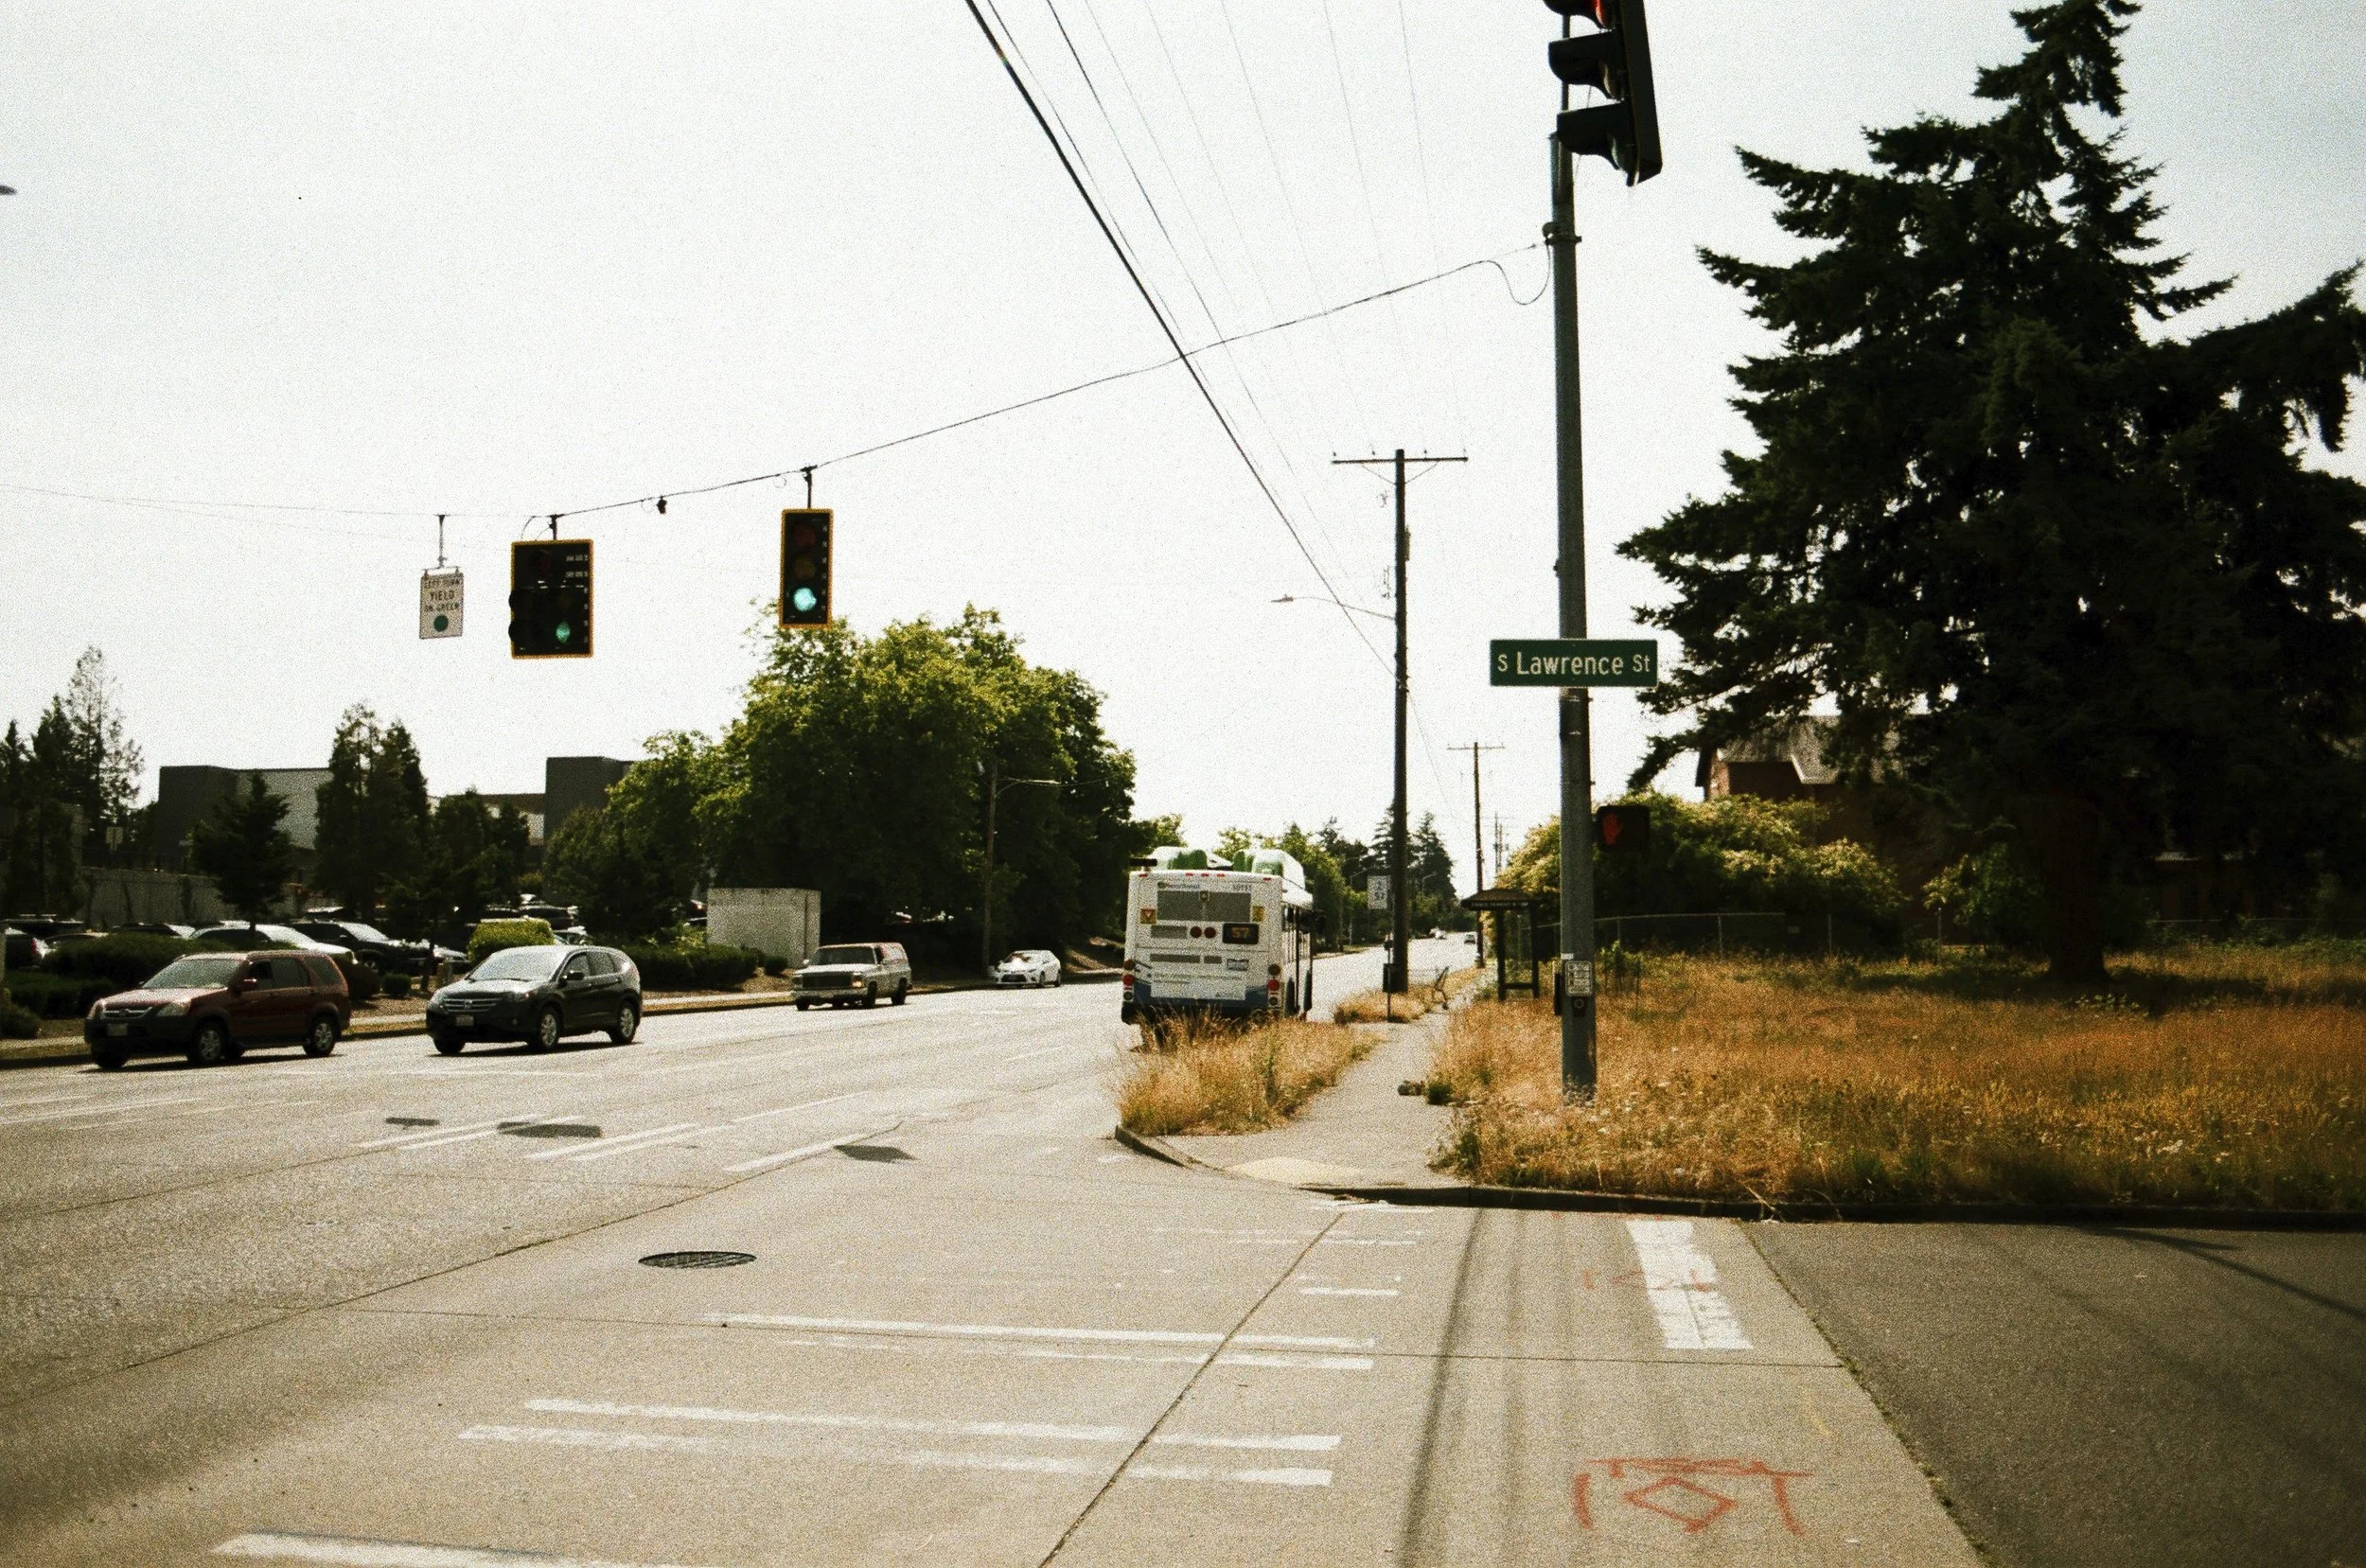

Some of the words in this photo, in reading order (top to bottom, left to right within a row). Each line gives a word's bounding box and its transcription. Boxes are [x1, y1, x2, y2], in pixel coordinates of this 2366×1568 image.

[430, 590, 455, 601] YIELD
[1497, 653, 1509, 672] S
[1516, 651, 1624, 676] Lawrence
[1632, 653, 1651, 673] St
